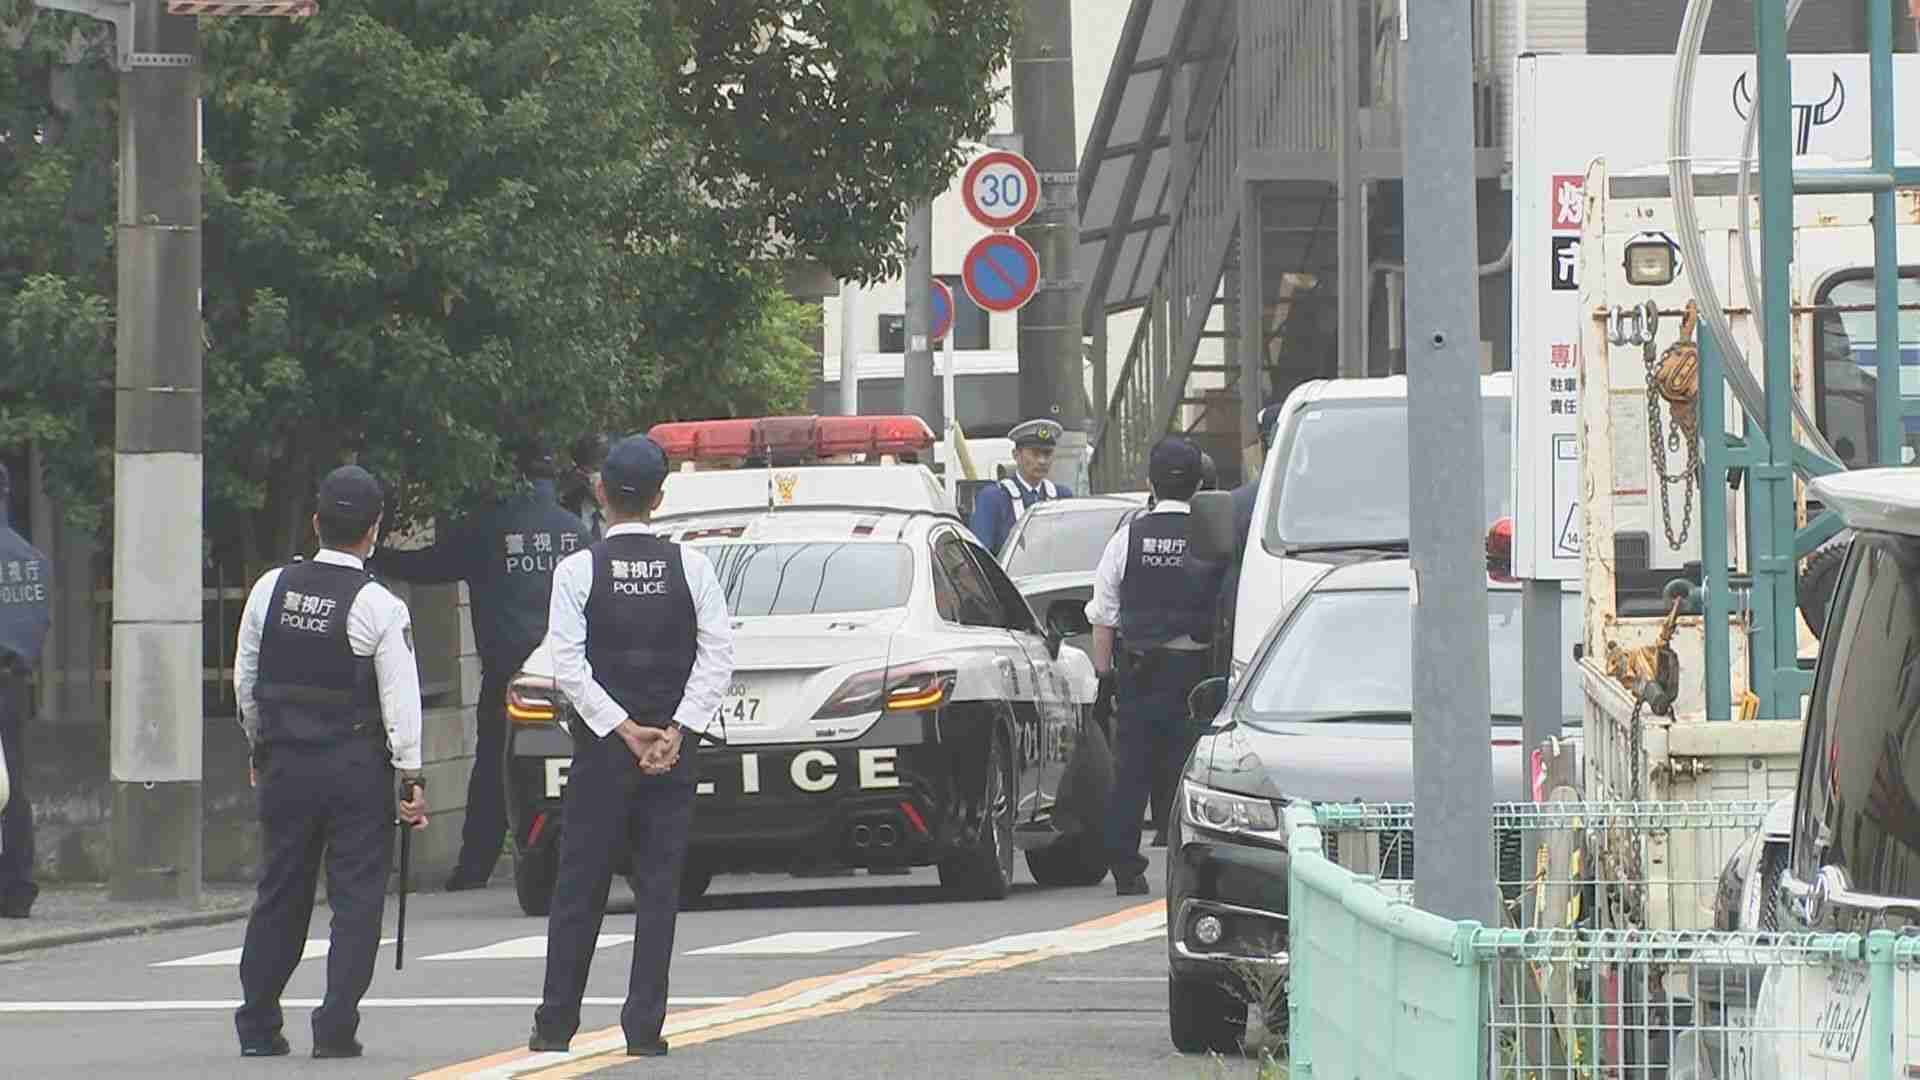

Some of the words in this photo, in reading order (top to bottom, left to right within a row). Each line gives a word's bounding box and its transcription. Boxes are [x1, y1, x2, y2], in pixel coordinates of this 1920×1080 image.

[980, 173, 1021, 207] 30
[505, 533, 578, 553] 警視庁
[1142, 537, 1187, 554] 警視庁
[0, 560, 41, 583] 視庁
[506, 556, 562, 573] POLI
[611, 559, 667, 579] 警視庁
[1142, 555, 1184, 568] POLICE
[613, 581, 667, 595] POLICE
[283, 591, 336, 617] 警視庁
[280, 612, 329, 633] POLICE
[545, 748, 901, 798] PICE
